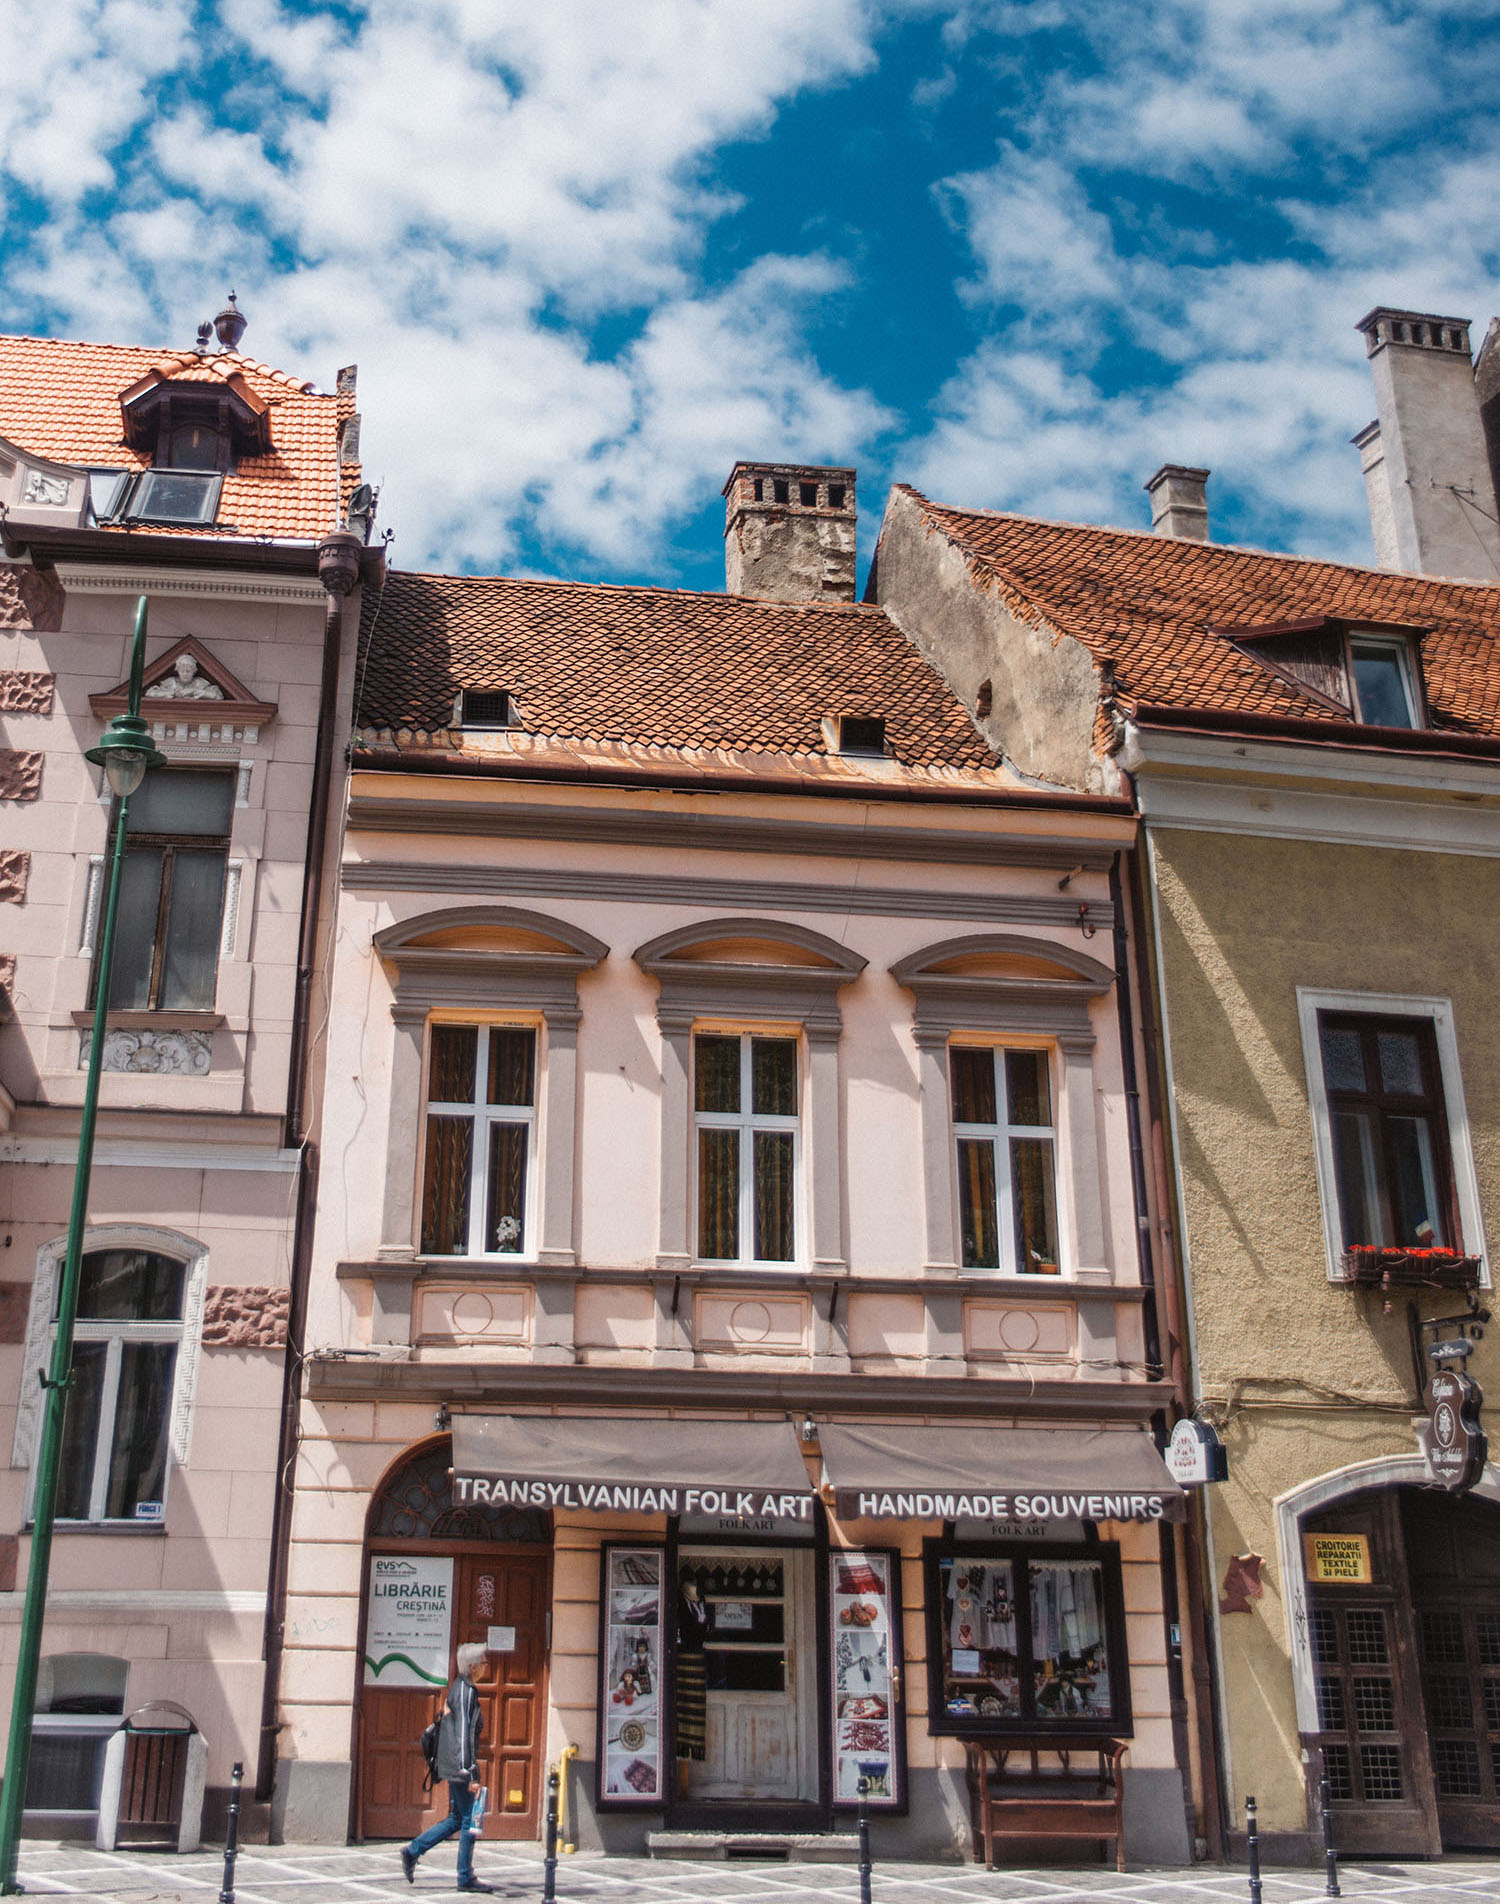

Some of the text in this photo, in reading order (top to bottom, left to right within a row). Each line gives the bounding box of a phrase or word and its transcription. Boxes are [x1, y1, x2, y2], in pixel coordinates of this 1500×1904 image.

[455, 1477, 813, 1518] TRANSYLVANIAN FOLK ART
[859, 1493, 1164, 1518] HANDMADE SOUVENIRS
[719, 1518, 776, 1531] FOLK ART
[991, 1524, 1046, 1537] FOLK ART
[1315, 1541, 1361, 1551] CROITORIE
[1317, 1551, 1362, 1560] REPARATII
[376, 1560, 396, 1570] evs
[1322, 1559, 1359, 1568] TEXTILE
[1323, 1568, 1360, 1577] SI PIELE
[374, 1581, 447, 1598] LIBRĂRIE
